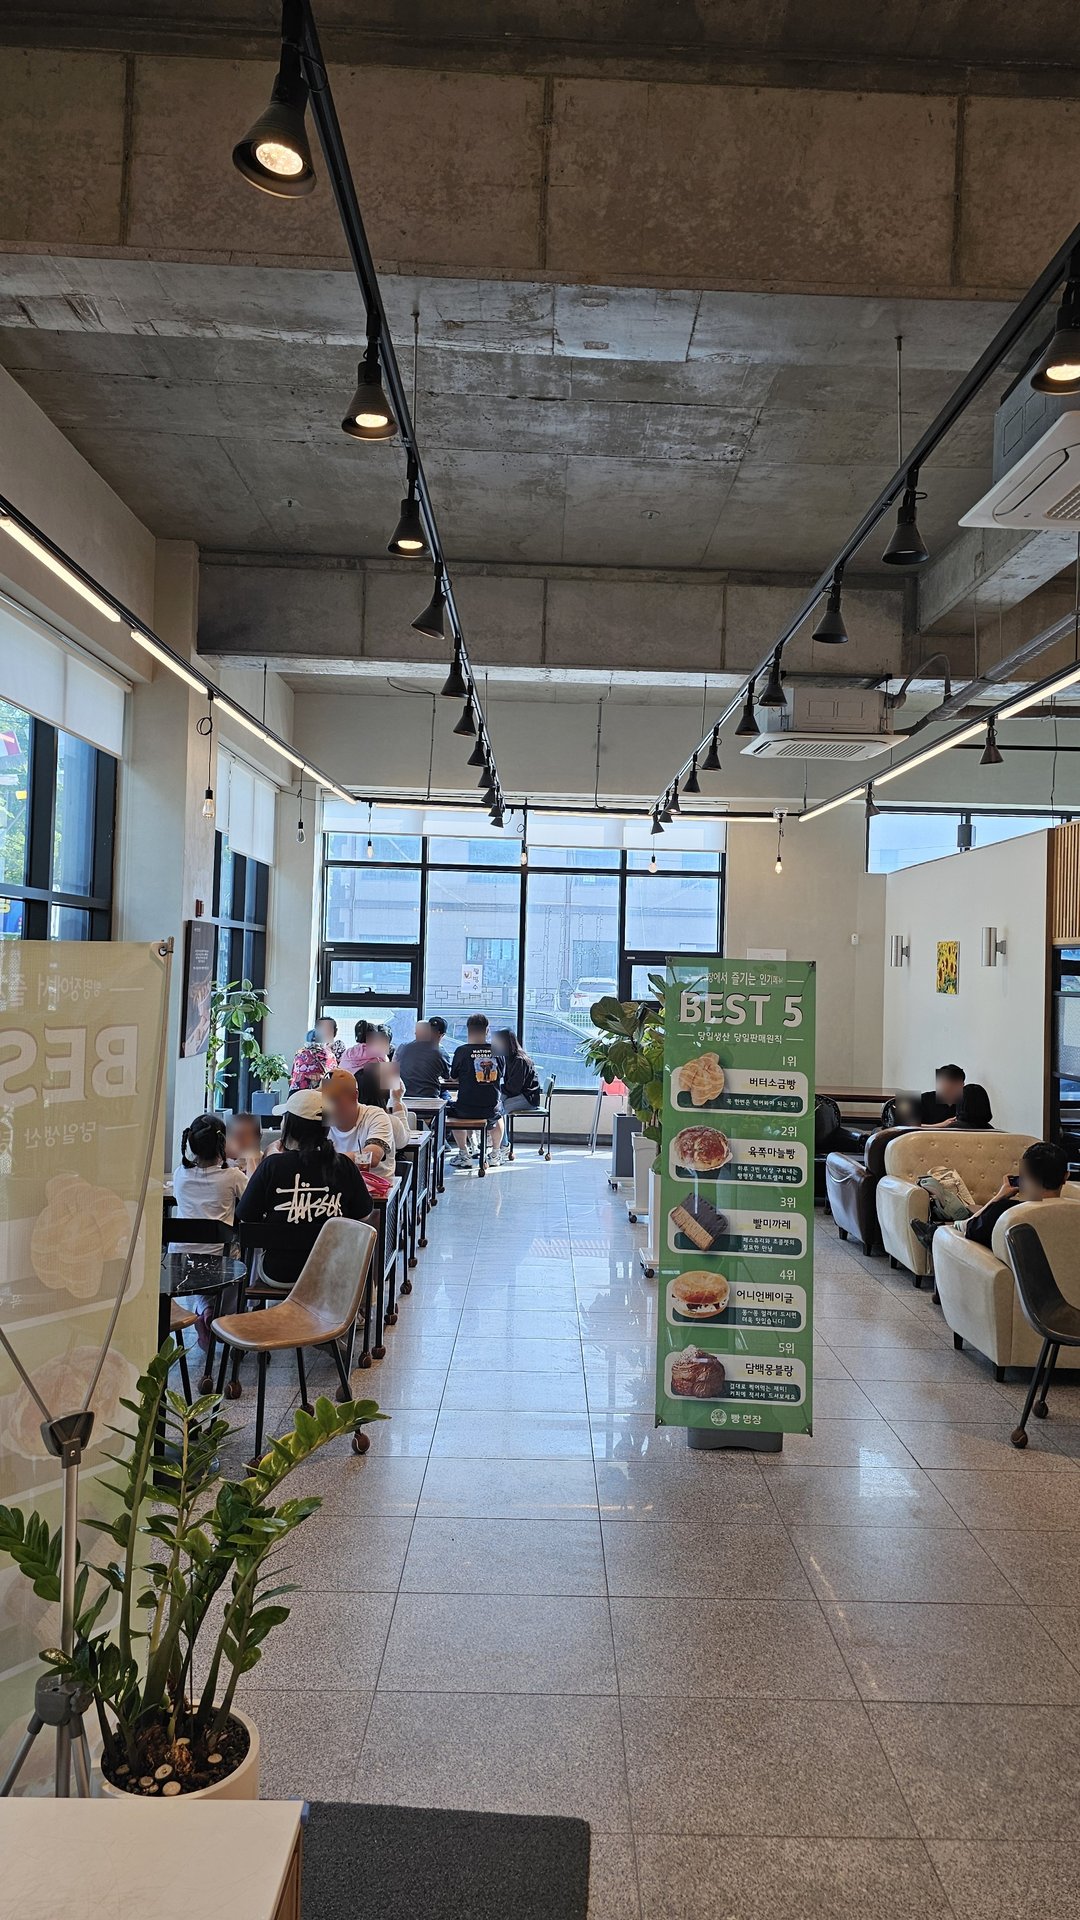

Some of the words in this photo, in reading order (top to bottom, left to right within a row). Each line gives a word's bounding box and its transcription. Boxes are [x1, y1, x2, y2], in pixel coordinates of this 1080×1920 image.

[703, 972, 728, 985] 장에서
[731, 971, 756, 986] 즐기는
[679, 991, 771, 1026] BEST
[783, 994, 803, 1028] 5
[698, 1031, 730, 1042] 당일생산
[734, 1033, 783, 1044] 당일판매원칙
[782, 1056, 797, 1067] 1위
[749, 1077, 796, 1090] 버터소금빵
[781, 1126, 797, 1137] 2위
[748, 1146, 795, 1160] 육쪽마늘빵
[780, 1197, 796, 1208] 3위
[752, 1218, 791, 1230] 빨미까레
[779, 1270, 796, 1281] 4위
[736, 1290, 794, 1304] 어니언베이글
[779, 1343, 795, 1354] 5위
[745, 1363, 794, 1377] 담백몽블랑
